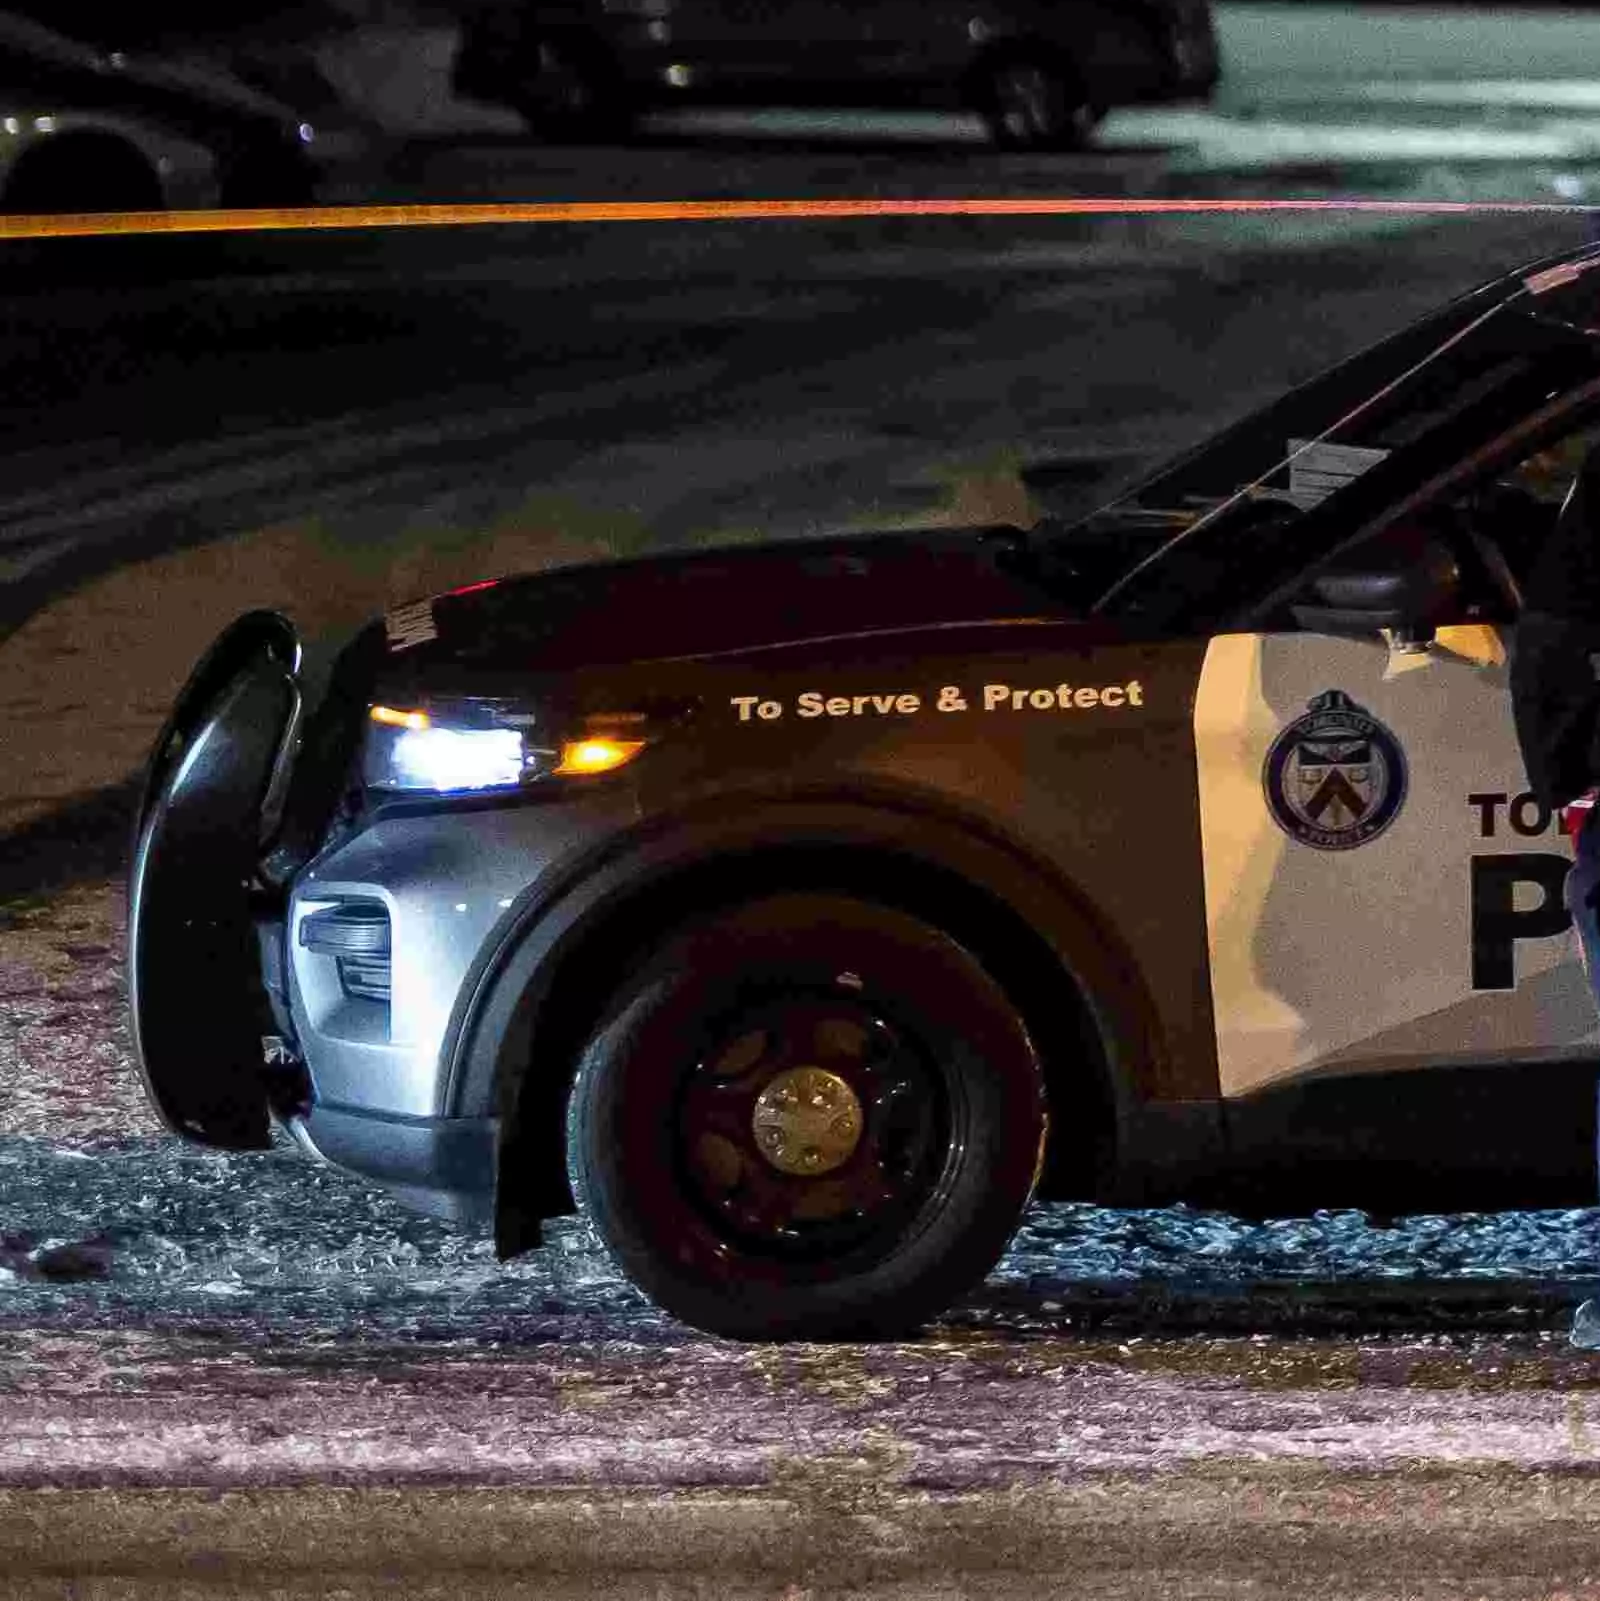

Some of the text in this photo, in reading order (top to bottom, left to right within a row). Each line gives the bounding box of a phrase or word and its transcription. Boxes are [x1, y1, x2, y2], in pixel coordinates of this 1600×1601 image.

[730, 679, 1144, 722] To Serve & Protect
